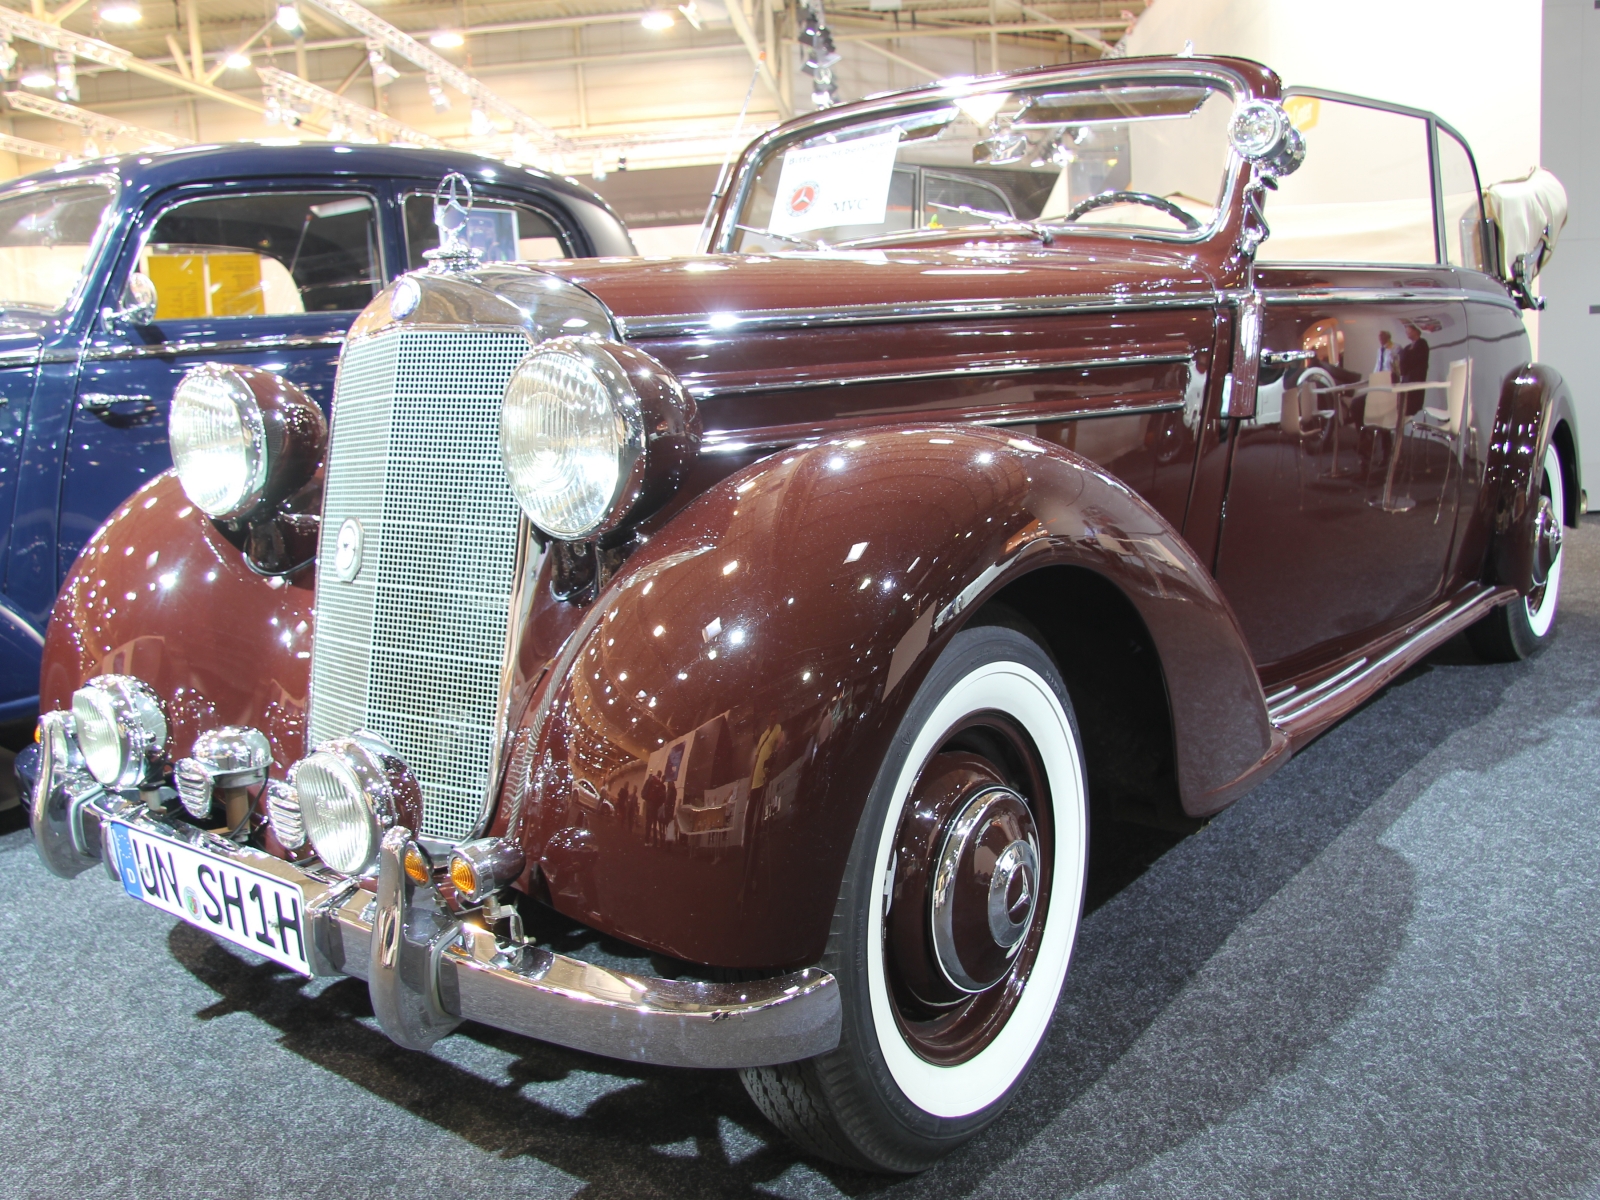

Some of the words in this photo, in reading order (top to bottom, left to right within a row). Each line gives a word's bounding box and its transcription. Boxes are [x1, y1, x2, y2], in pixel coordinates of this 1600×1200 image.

[788, 156, 812, 166] Bitte
[831, 197, 869, 214] MVC
[126, 867, 137, 884] D
[132, 838, 184, 909] UN
[197, 863, 308, 963] SH1H
